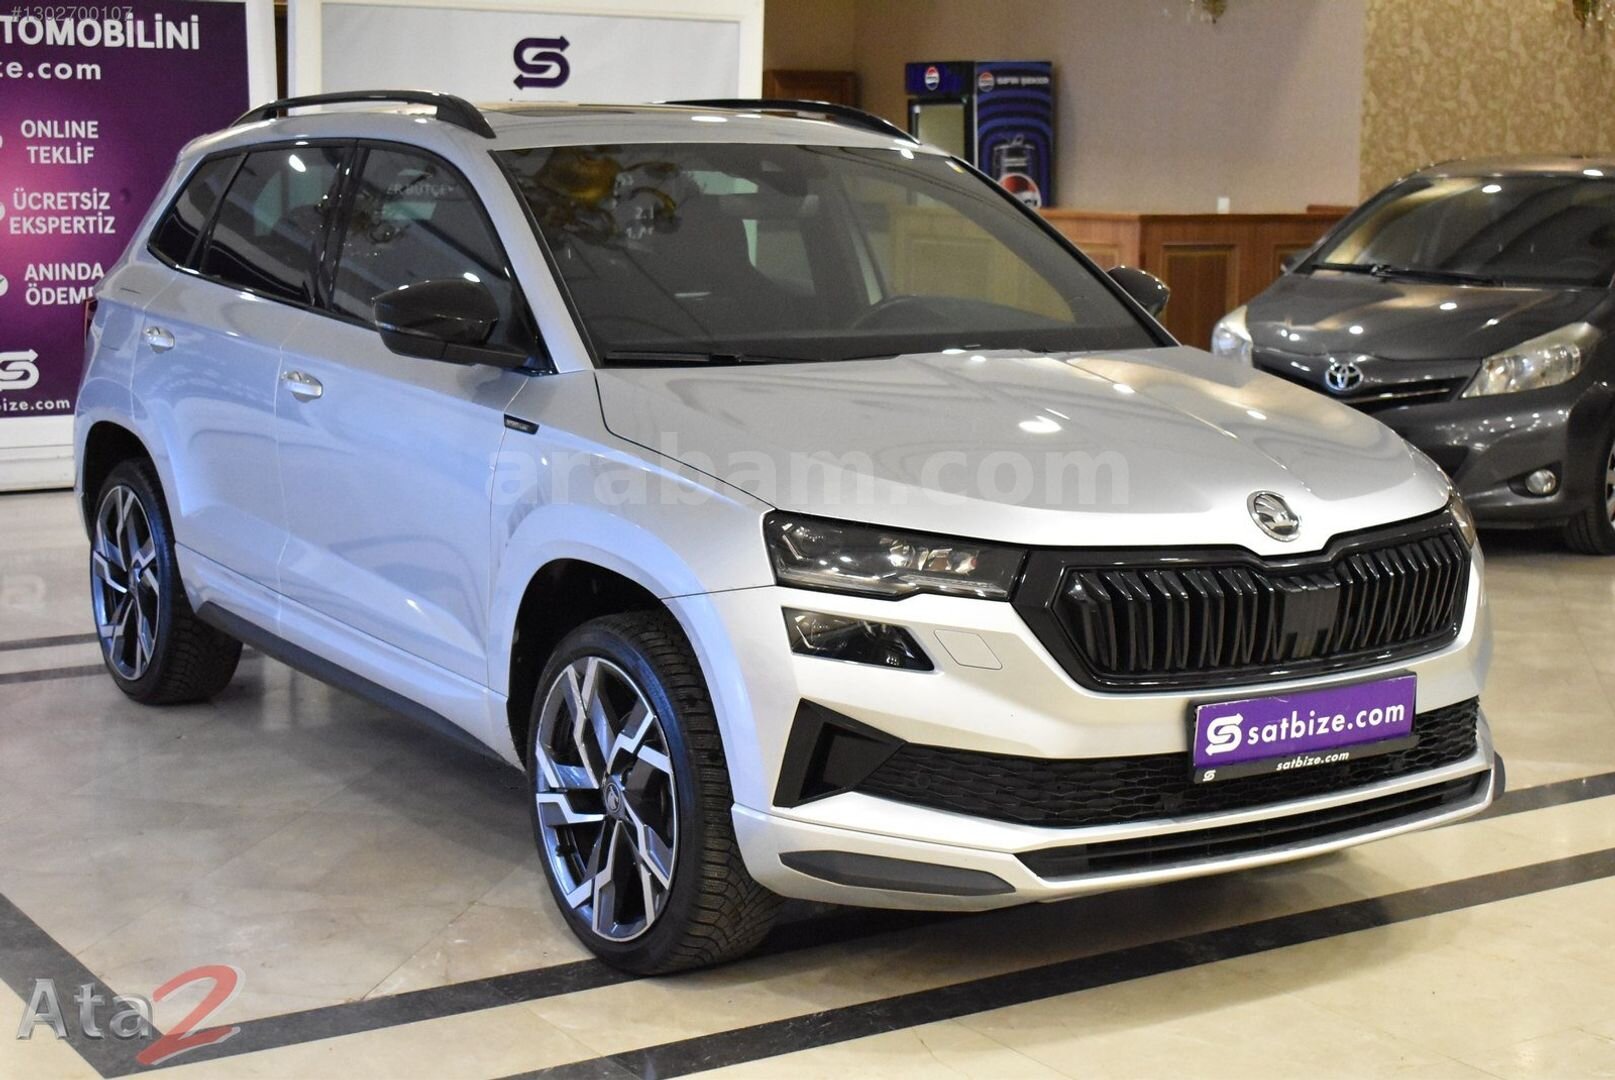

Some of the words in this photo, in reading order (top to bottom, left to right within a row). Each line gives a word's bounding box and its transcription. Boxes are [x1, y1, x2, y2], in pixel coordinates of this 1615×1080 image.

[0, 61, 102, 80] e.com
[20, 119, 99, 139] ONLINE
[26, 142, 95, 165] TEKLİF
[13, 187, 111, 211] ÜCRETSİZ
[9, 212, 116, 235] EKSPERTİZ
[24, 262, 105, 282] ANINDA
[0, 398, 71, 412] ize.com
[1247, 703, 1406, 745] satbize.com
[1275, 751, 1350, 771] satbize.com
